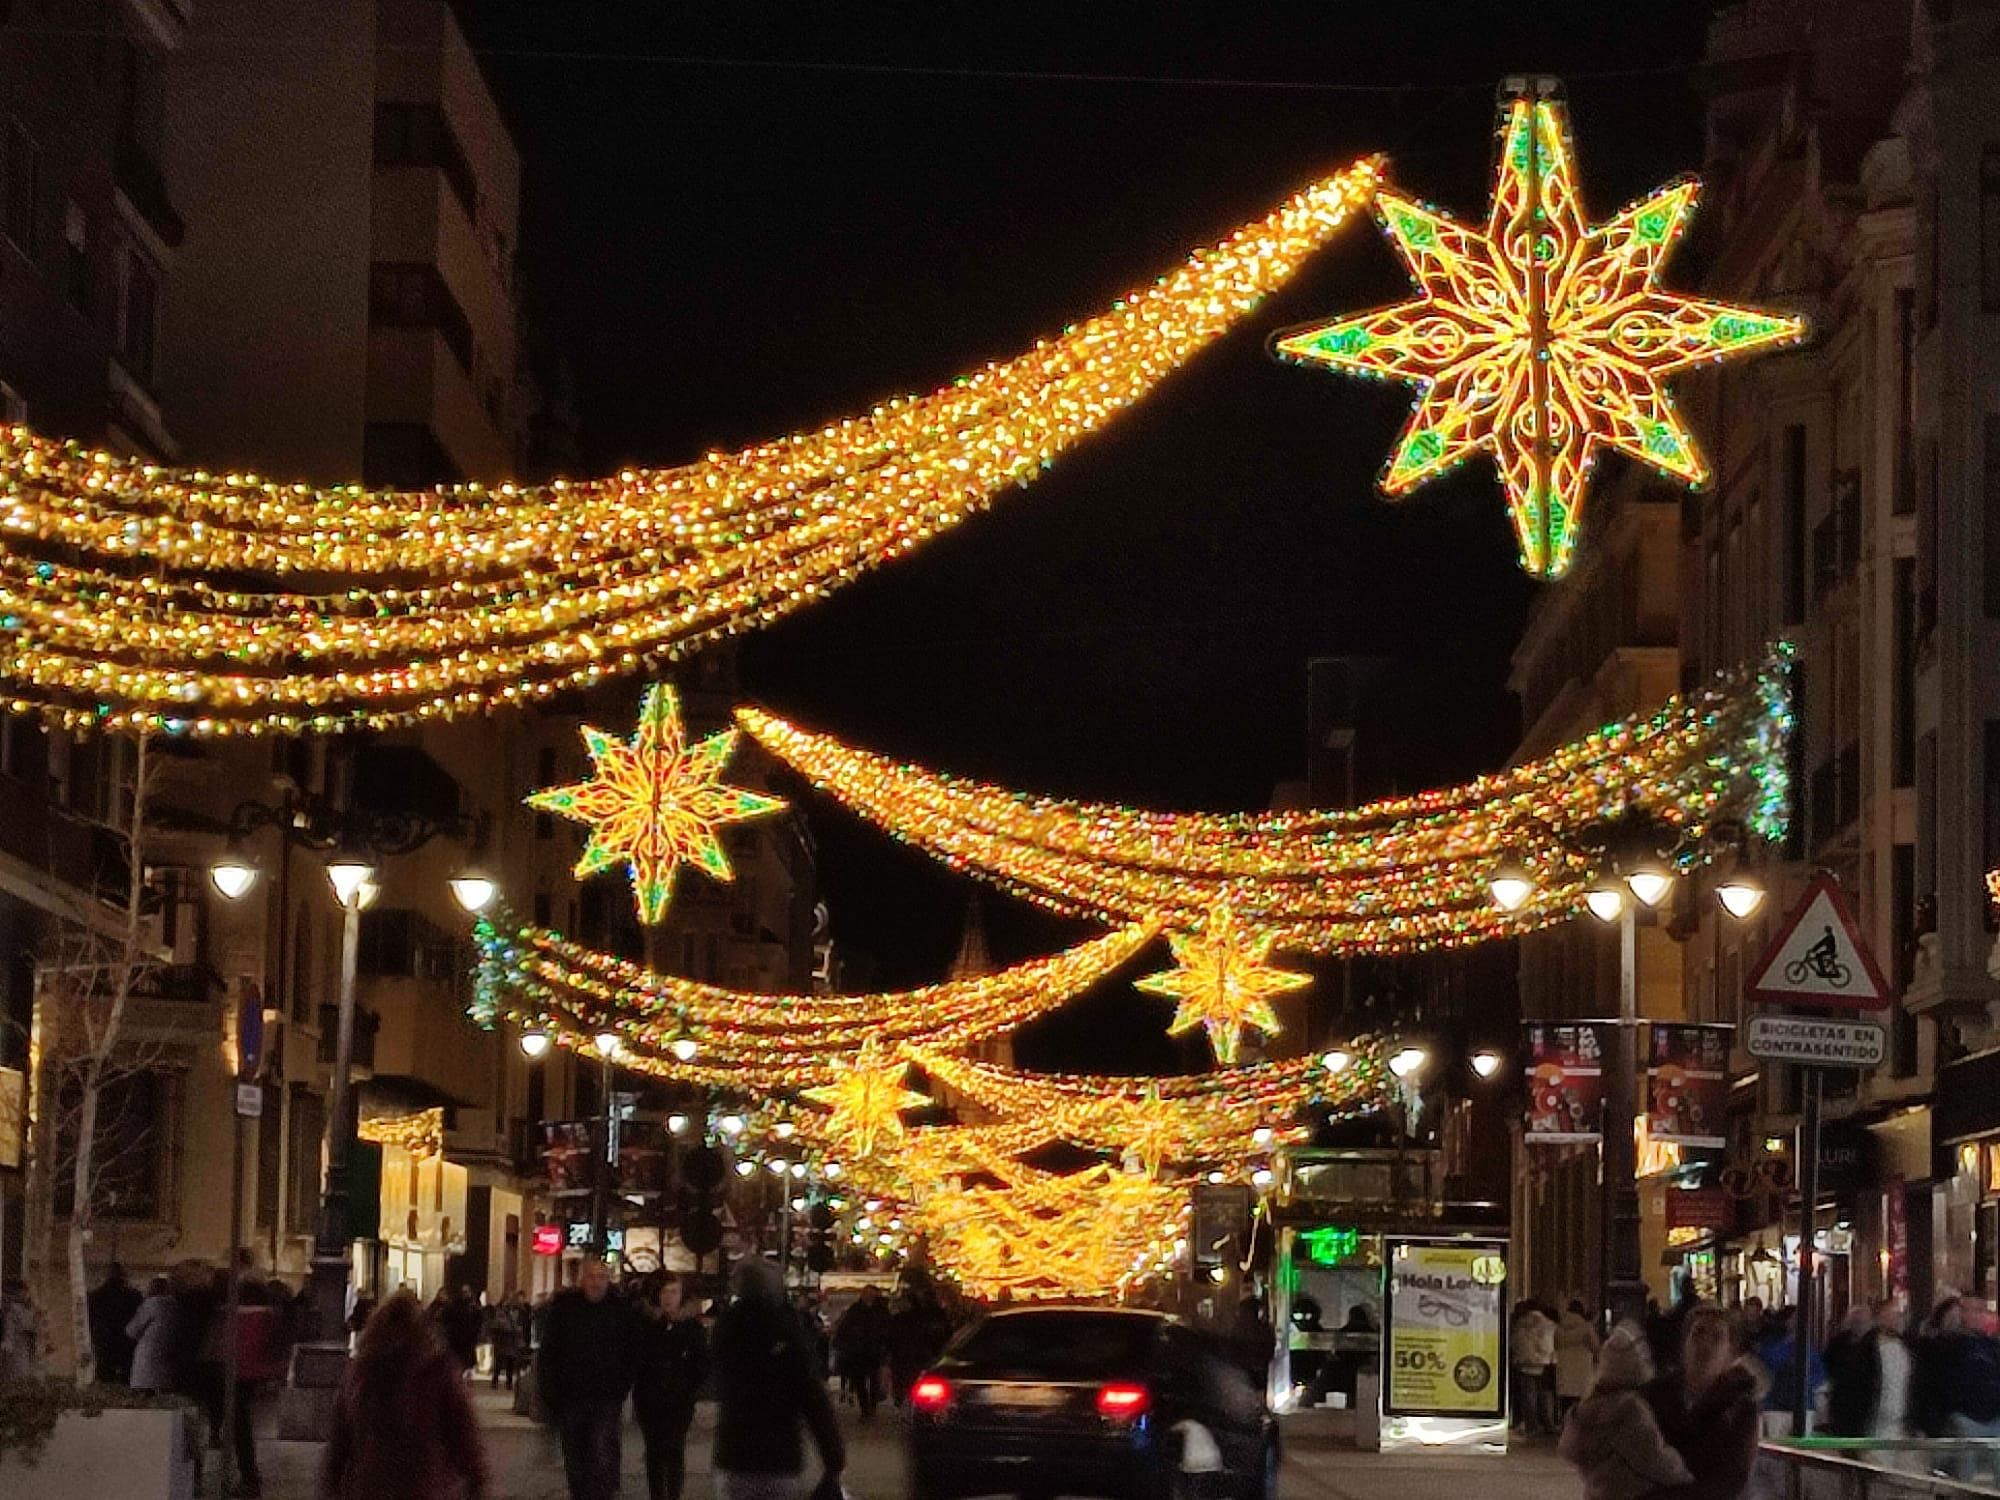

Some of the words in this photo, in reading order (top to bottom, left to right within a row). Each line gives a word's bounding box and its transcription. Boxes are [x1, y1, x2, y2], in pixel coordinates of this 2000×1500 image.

[1760, 1022, 1846, 1040] BICICLETAS
[1854, 1029, 1875, 1041] EN
[1751, 1039, 1879, 1059] CONTRASENTIDO
[1395, 1350, 1447, 1370] 50%
